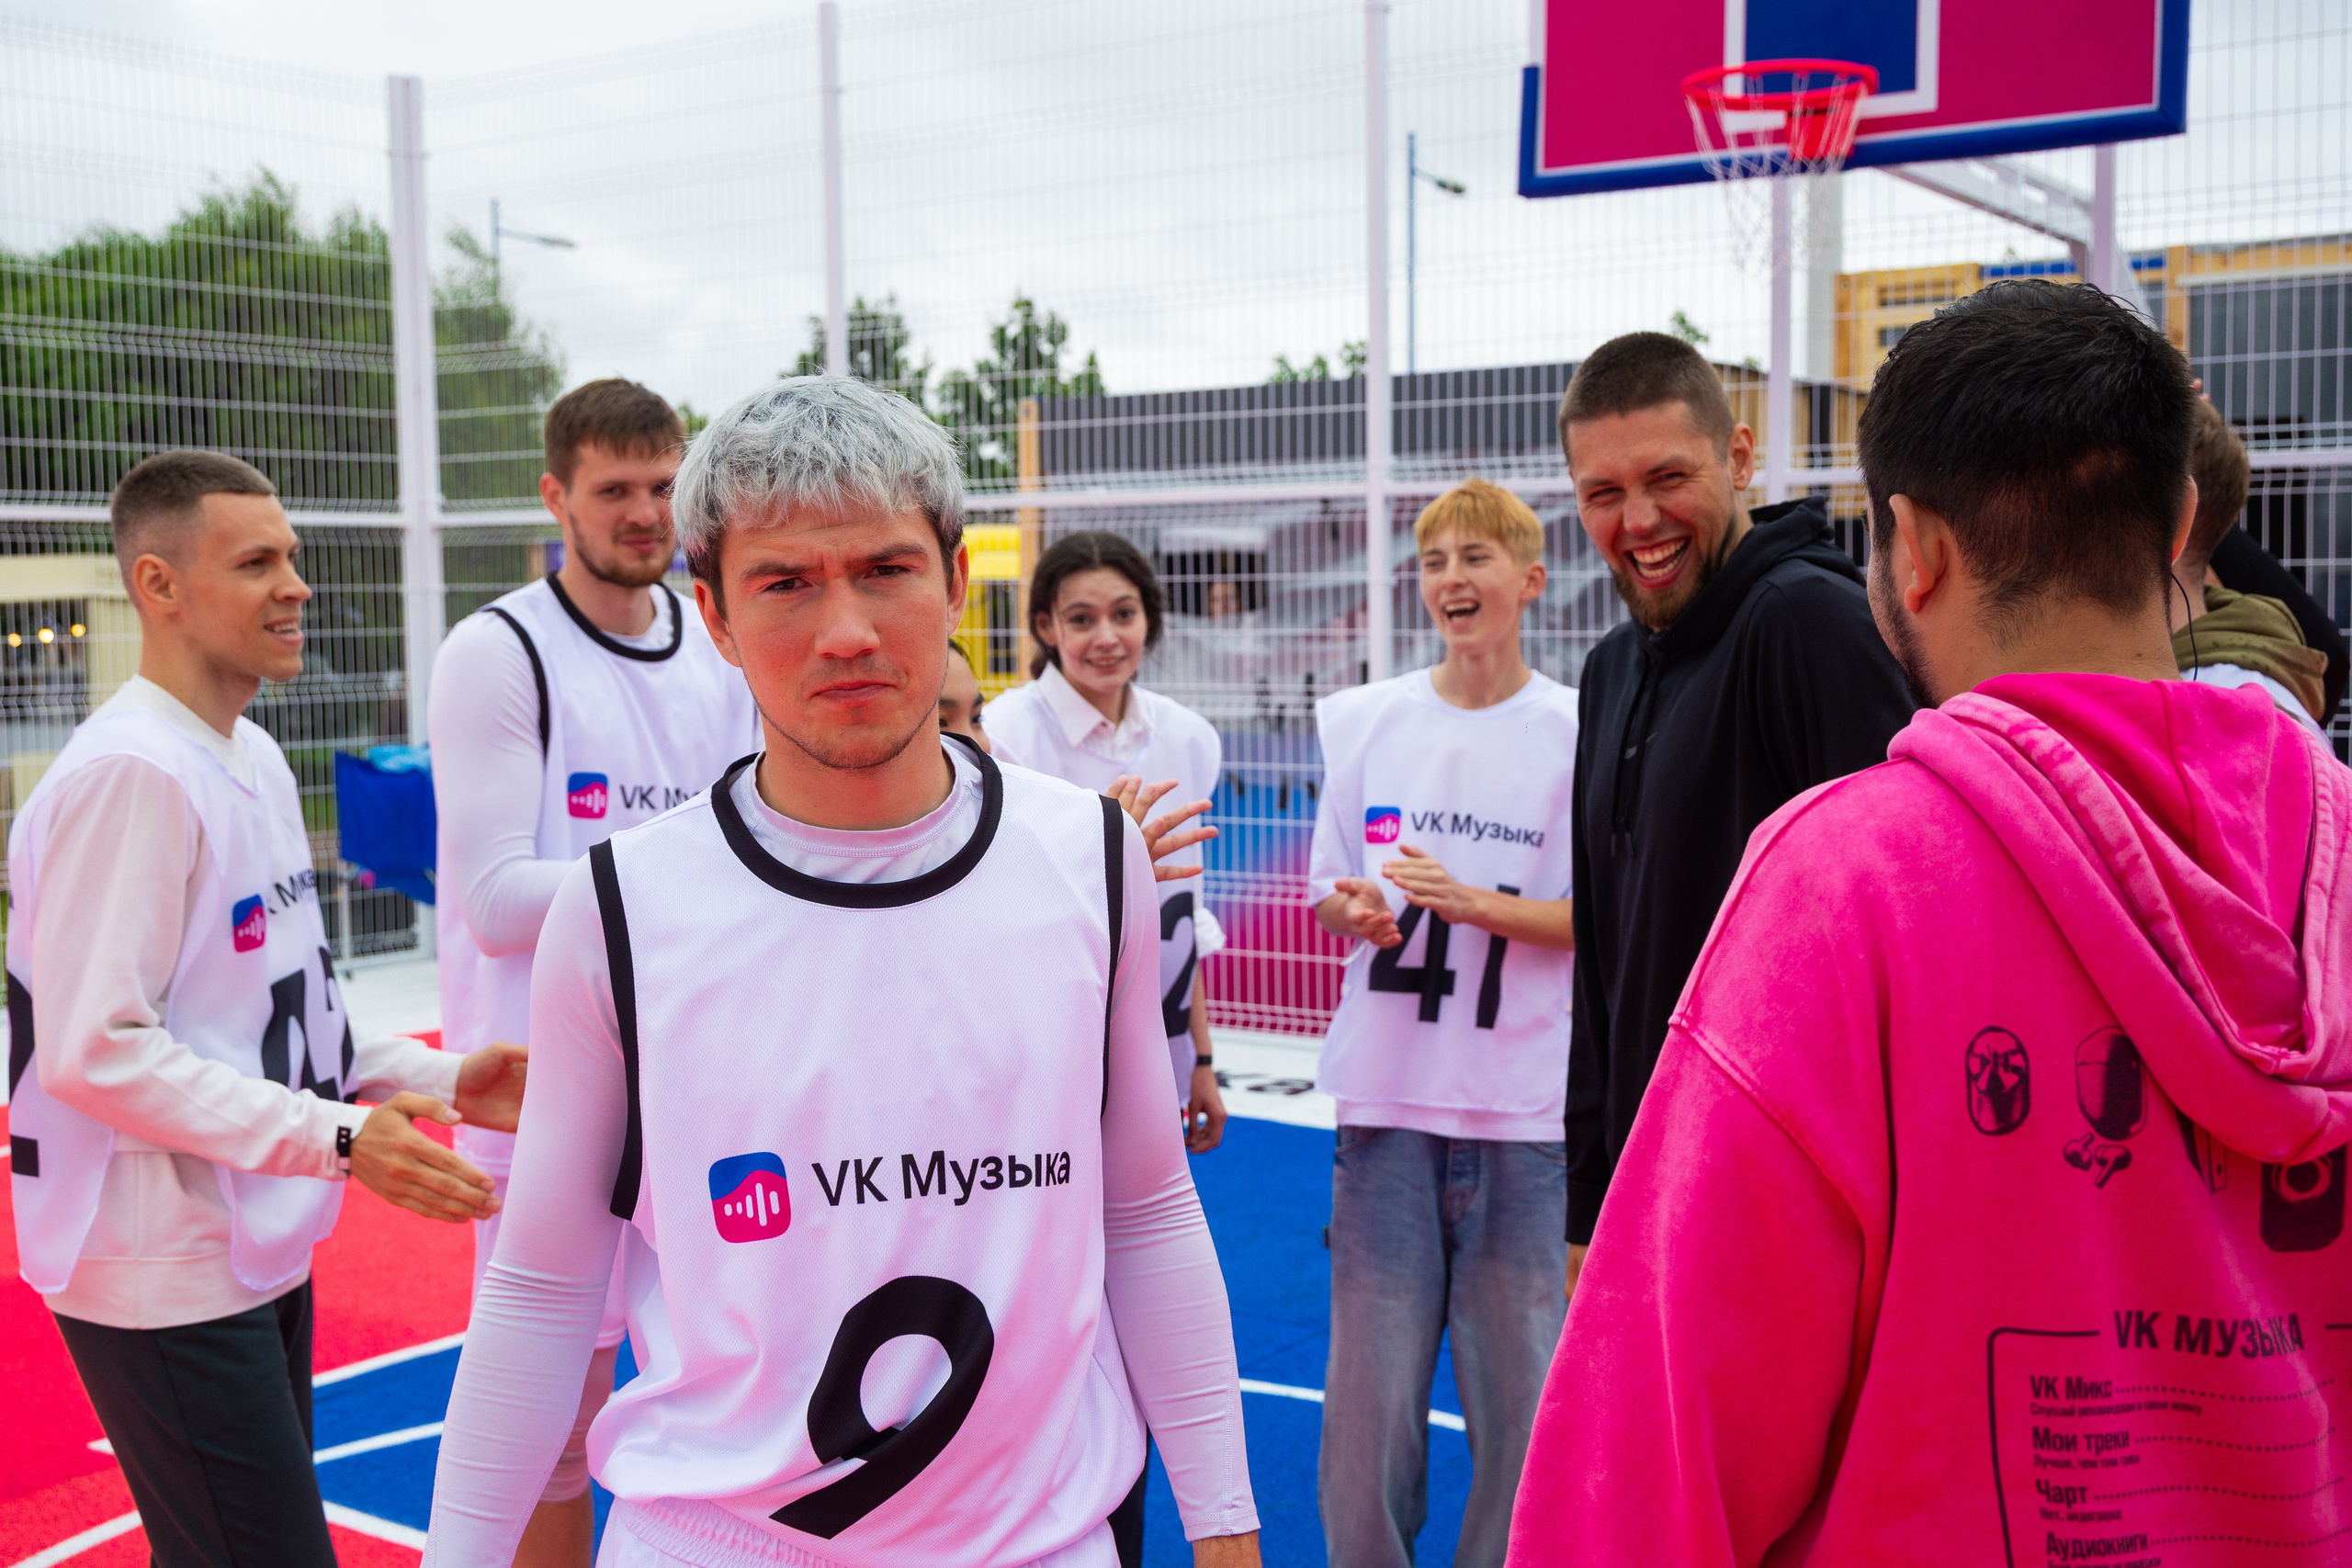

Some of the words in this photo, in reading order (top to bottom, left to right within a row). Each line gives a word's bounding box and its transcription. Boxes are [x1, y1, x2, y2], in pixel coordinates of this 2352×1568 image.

[619, 784, 656, 809] VK
[1411, 811, 1444, 834] VK
[1451, 811, 1545, 849] Музыка
[811, 1156, 888, 1207] VK
[900, 1149, 1071, 1207] Музыка
[2114, 1309, 2162, 1349] VK
[2030, 1374, 2059, 1400] VK
[2064, 1375, 2112, 1401] Микс
[768, 1275, 995, 1540] 9
[2031, 1427, 2078, 1451] Мои
[2083, 1430, 2131, 1456] треки
[2035, 1478, 2088, 1508] Чарт
[2046, 1531, 2148, 1562] Аудиокниги
